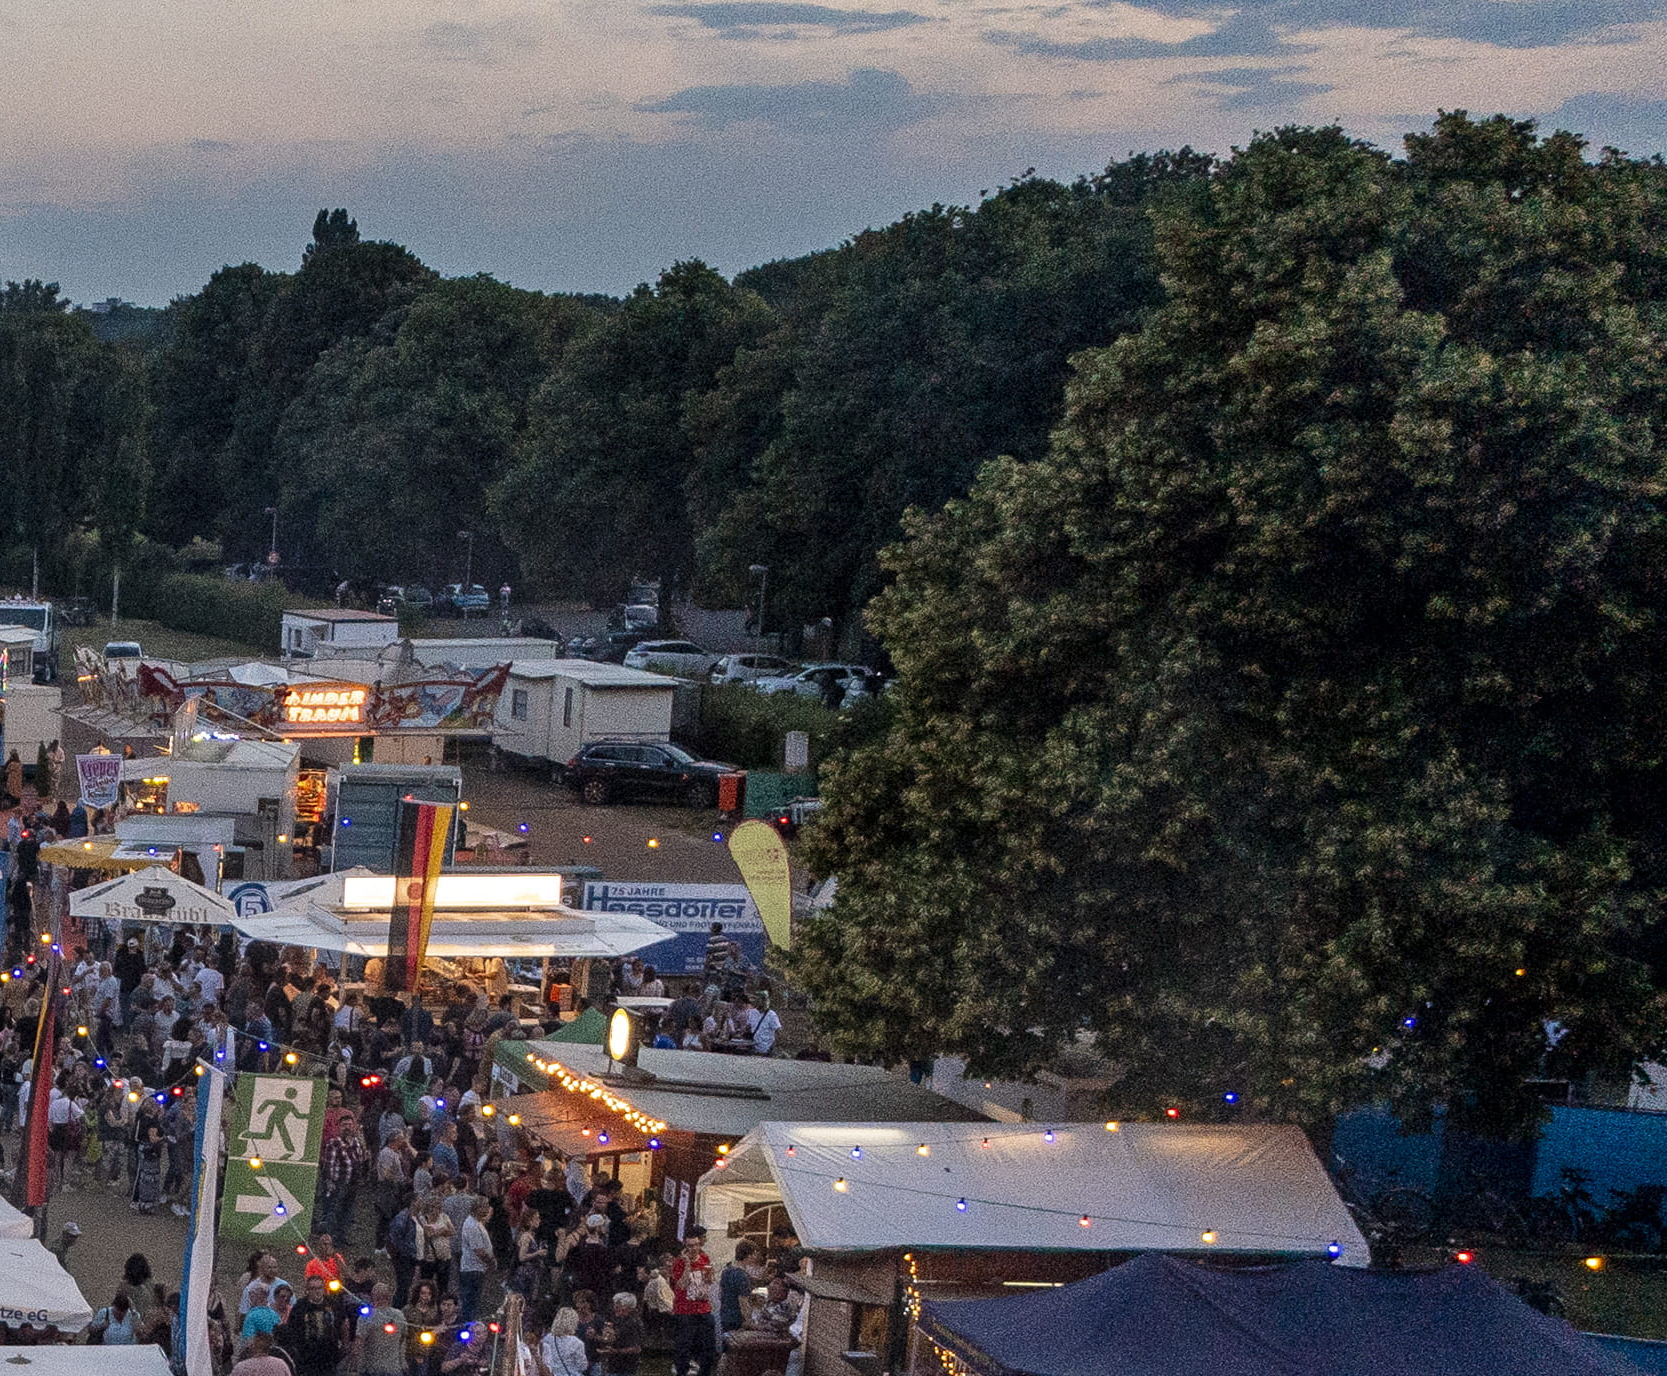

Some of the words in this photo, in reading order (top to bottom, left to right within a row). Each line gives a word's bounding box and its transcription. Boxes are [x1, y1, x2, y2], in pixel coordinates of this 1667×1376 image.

[289, 705, 360, 722] TRAUM
[611, 887, 625, 896] 75
[628, 887, 666, 897] JAHRE
[27, 1309, 49, 1322] eG
